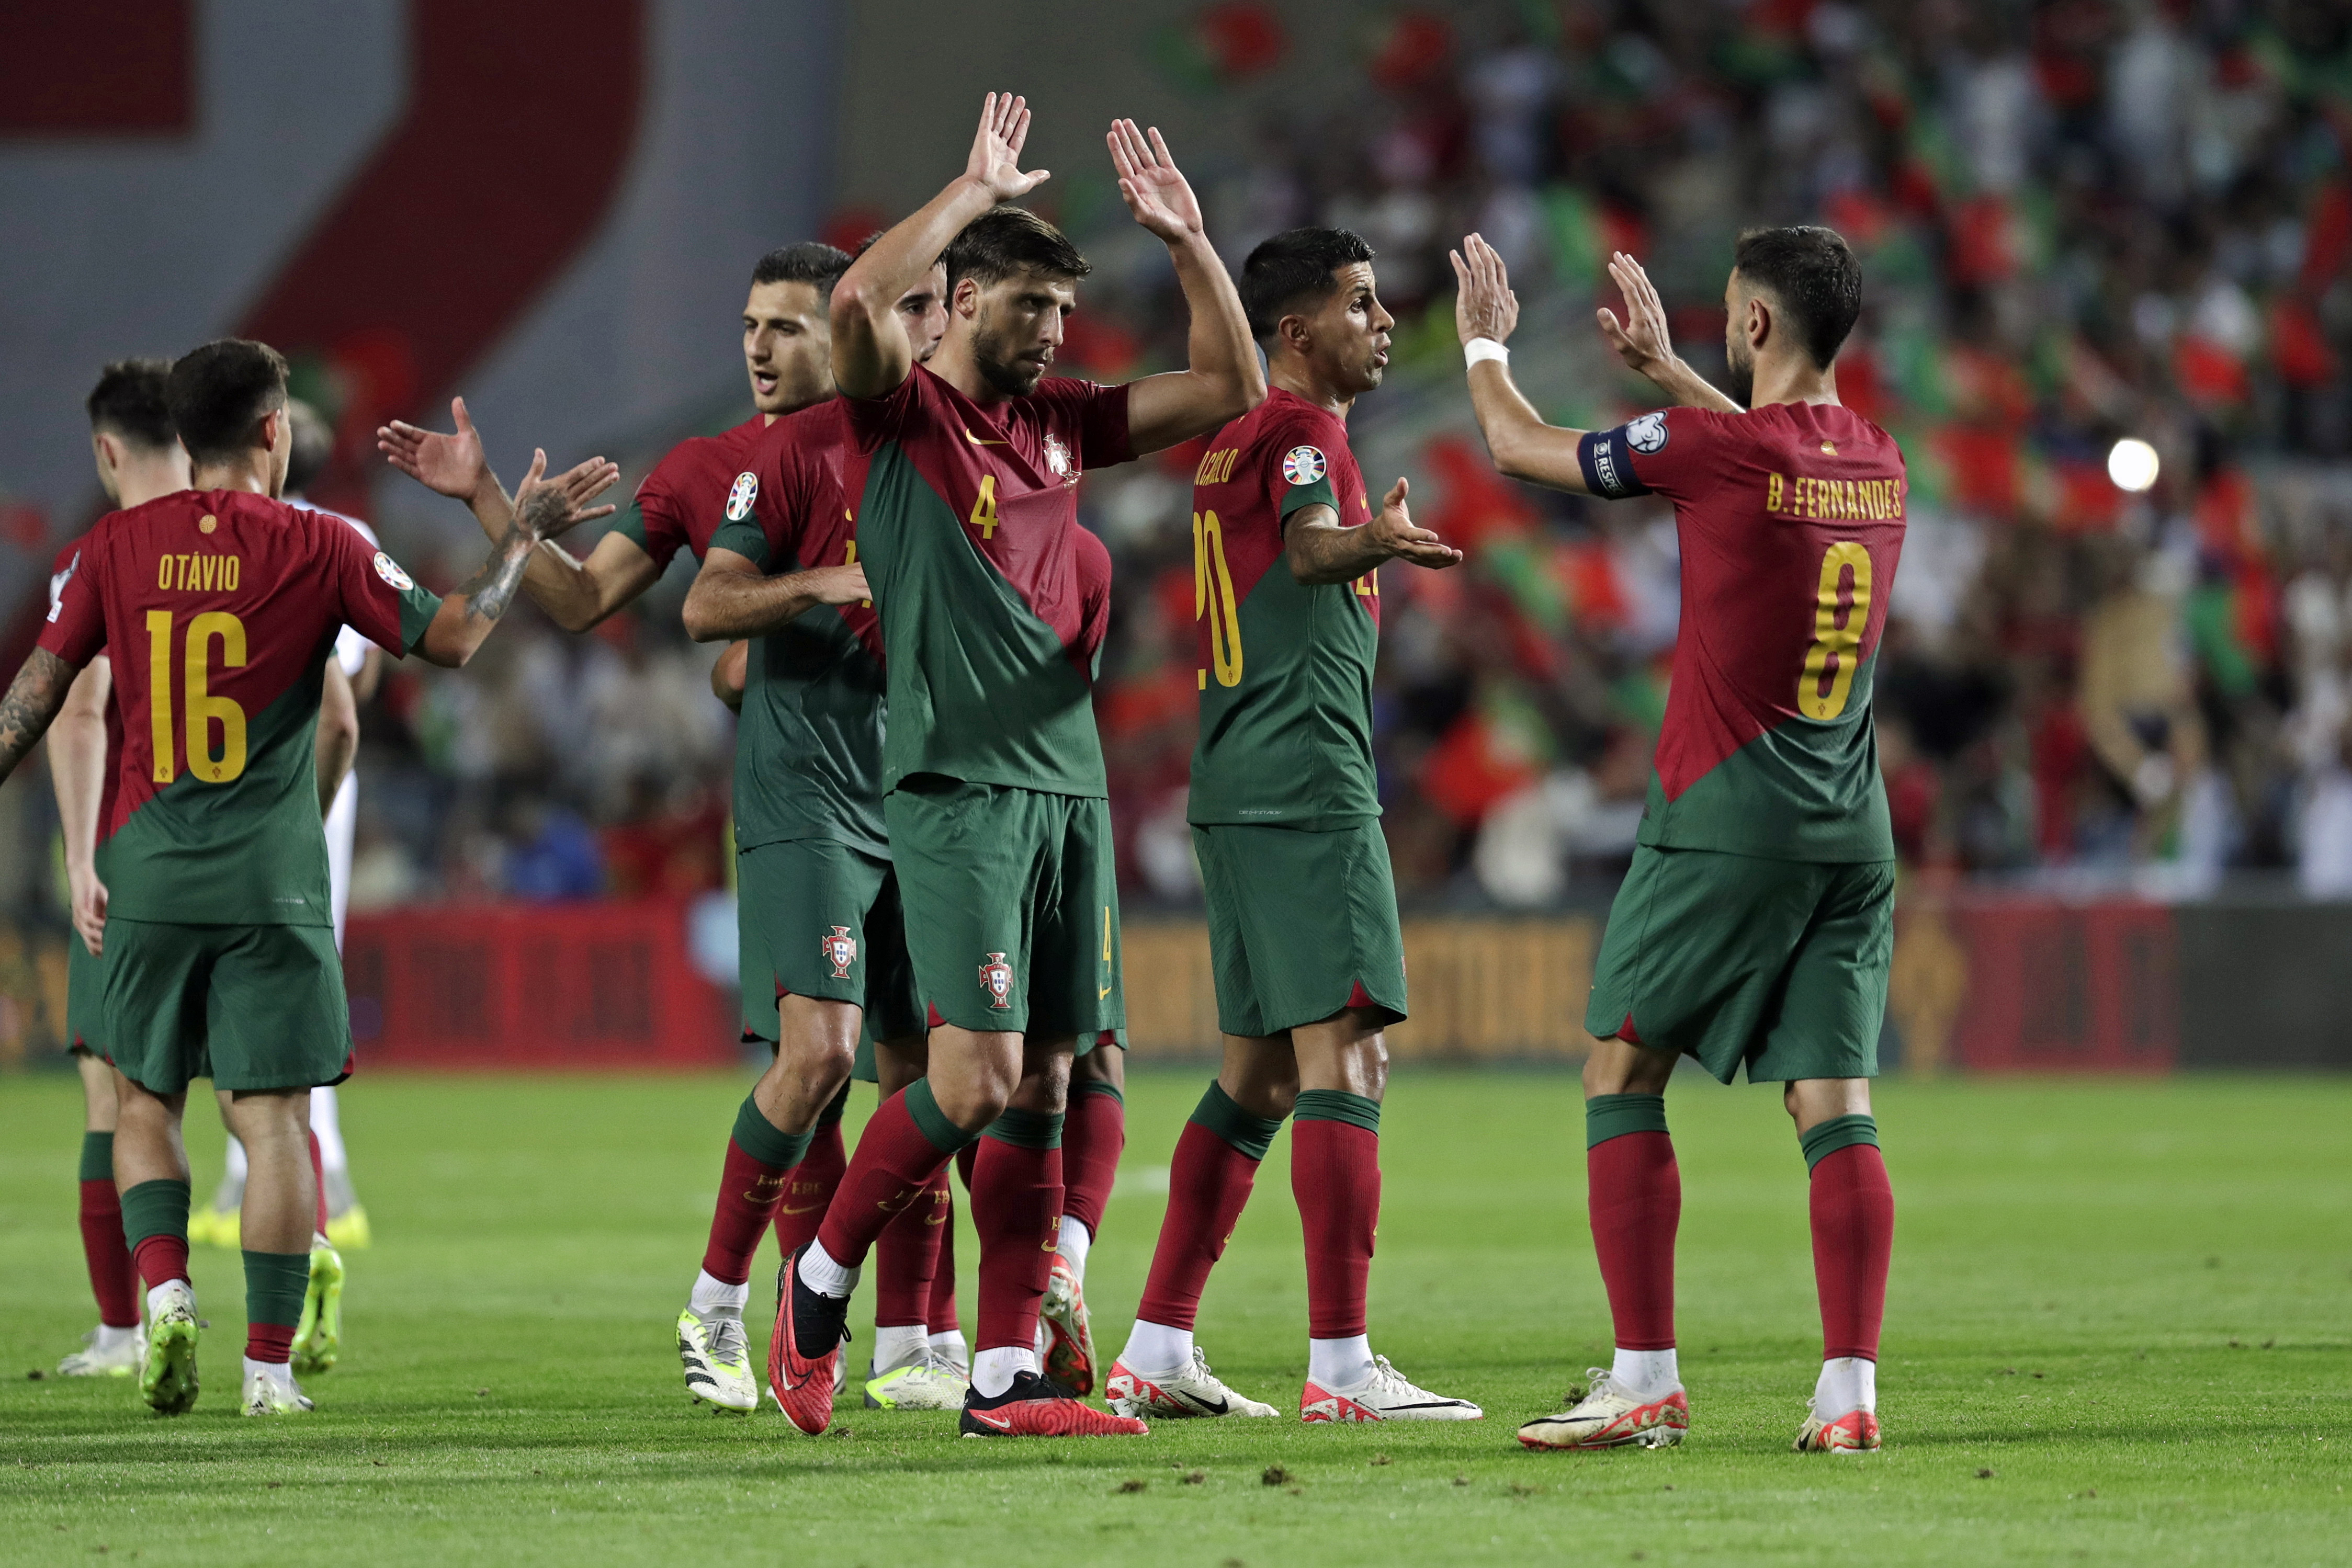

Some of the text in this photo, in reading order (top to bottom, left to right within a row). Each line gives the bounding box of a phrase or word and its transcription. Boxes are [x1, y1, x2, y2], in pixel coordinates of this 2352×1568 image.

[969, 474, 999, 539] 4
[1794, 478, 1901, 519] FERNANDES
[158, 551, 240, 592] OTÁVIO
[1797, 541, 1872, 720] 8
[146, 610, 247, 783] 16
[1103, 905, 1111, 973] 4
